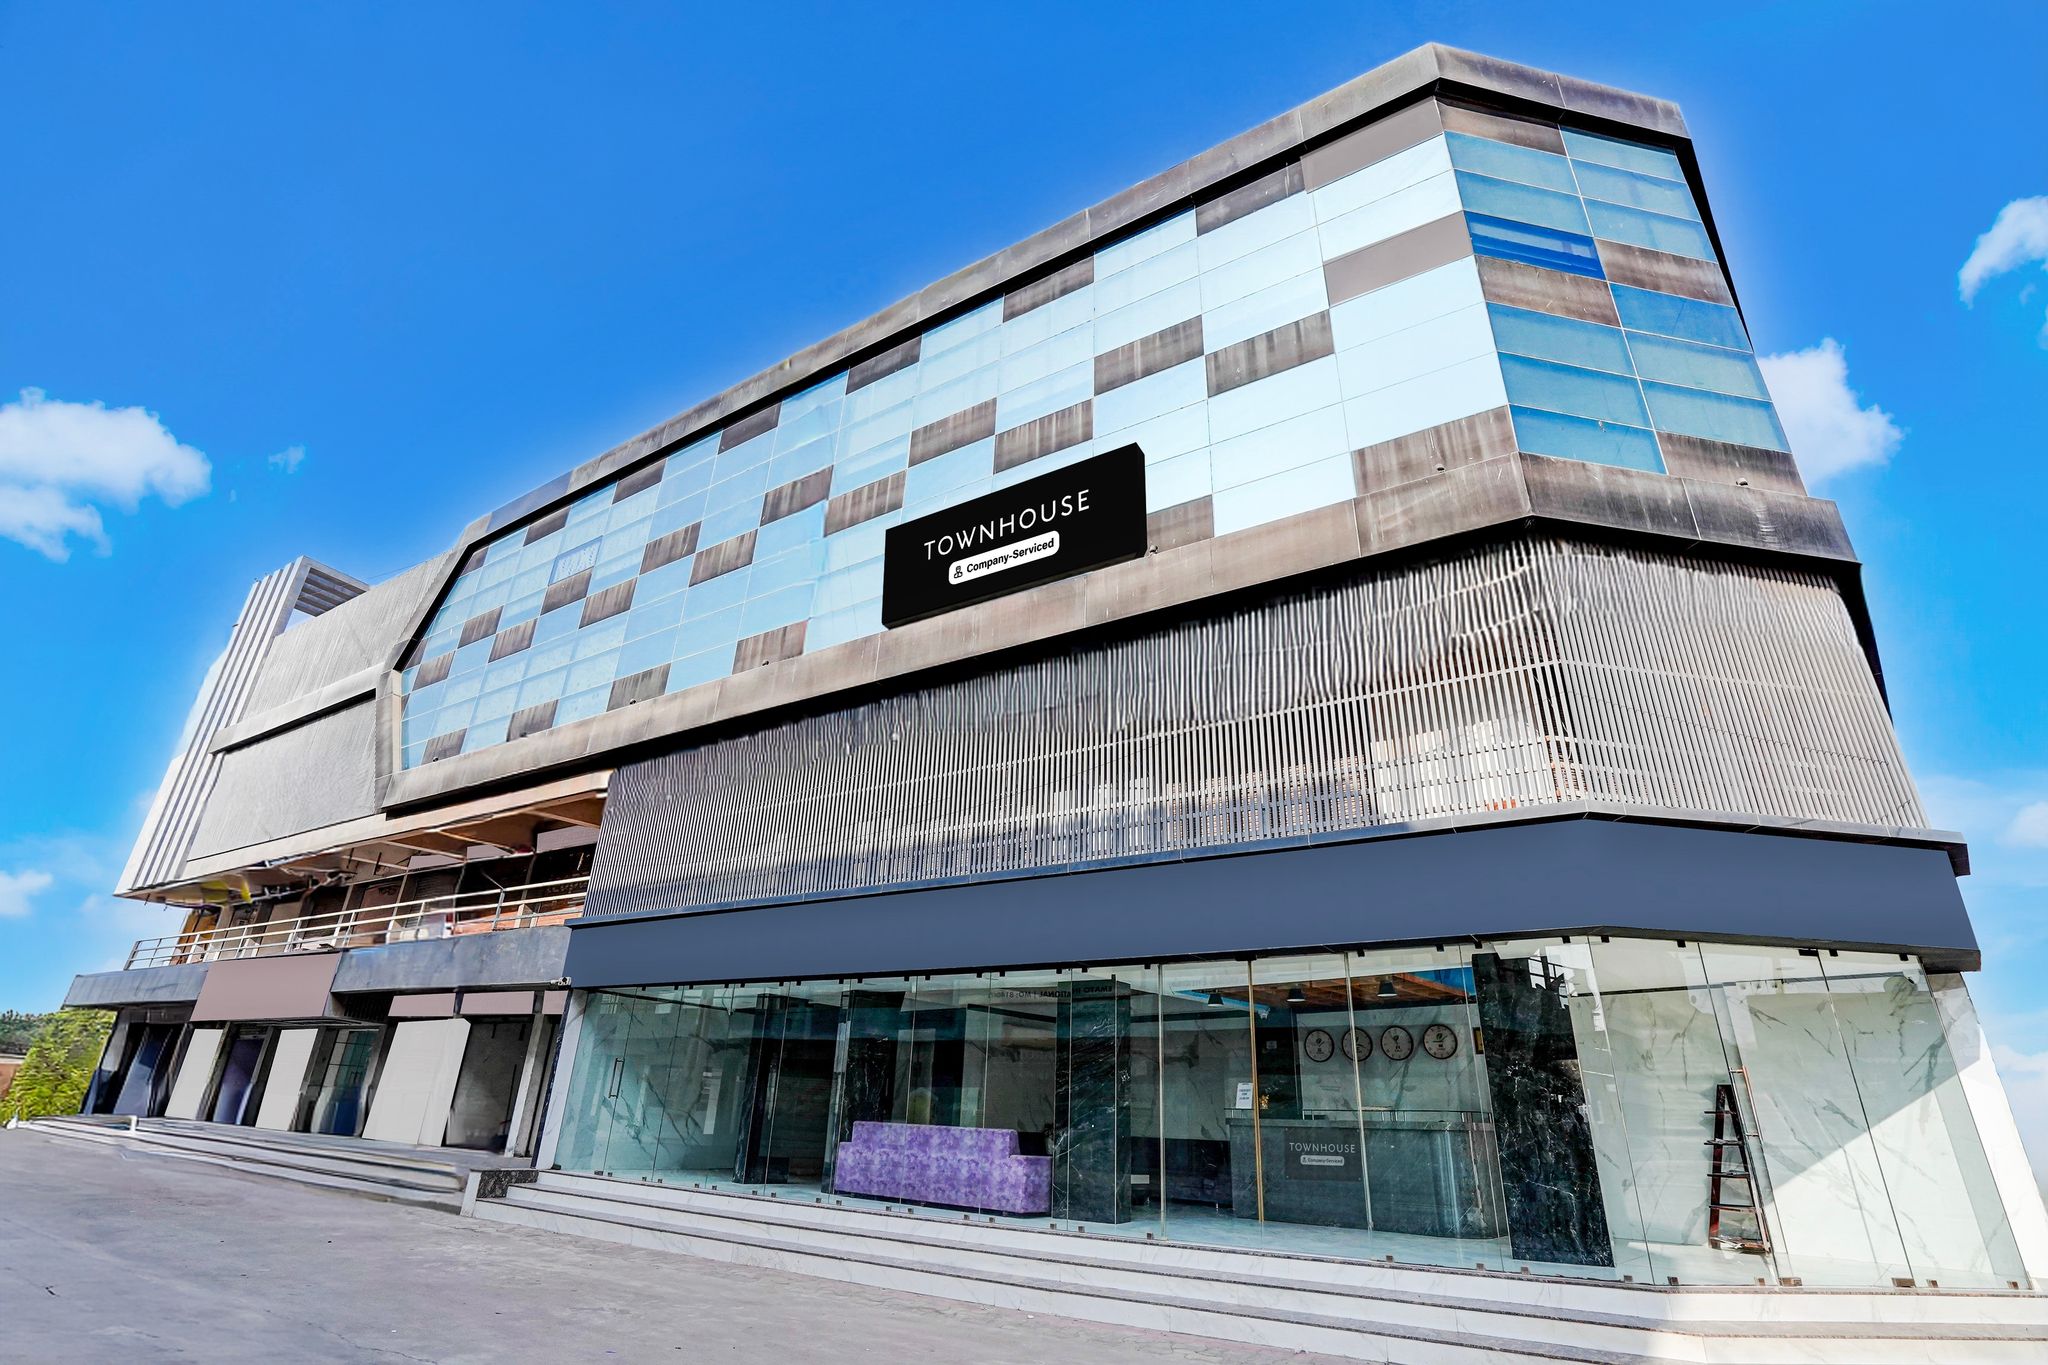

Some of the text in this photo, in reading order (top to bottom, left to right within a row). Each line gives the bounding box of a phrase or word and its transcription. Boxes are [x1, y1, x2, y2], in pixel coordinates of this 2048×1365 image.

[924, 489, 1090, 560] TOWNHOUSE
[966, 538, 1055, 573] Company-Serviced
[1289, 1142, 1356, 1153] TOWNHOUSE
